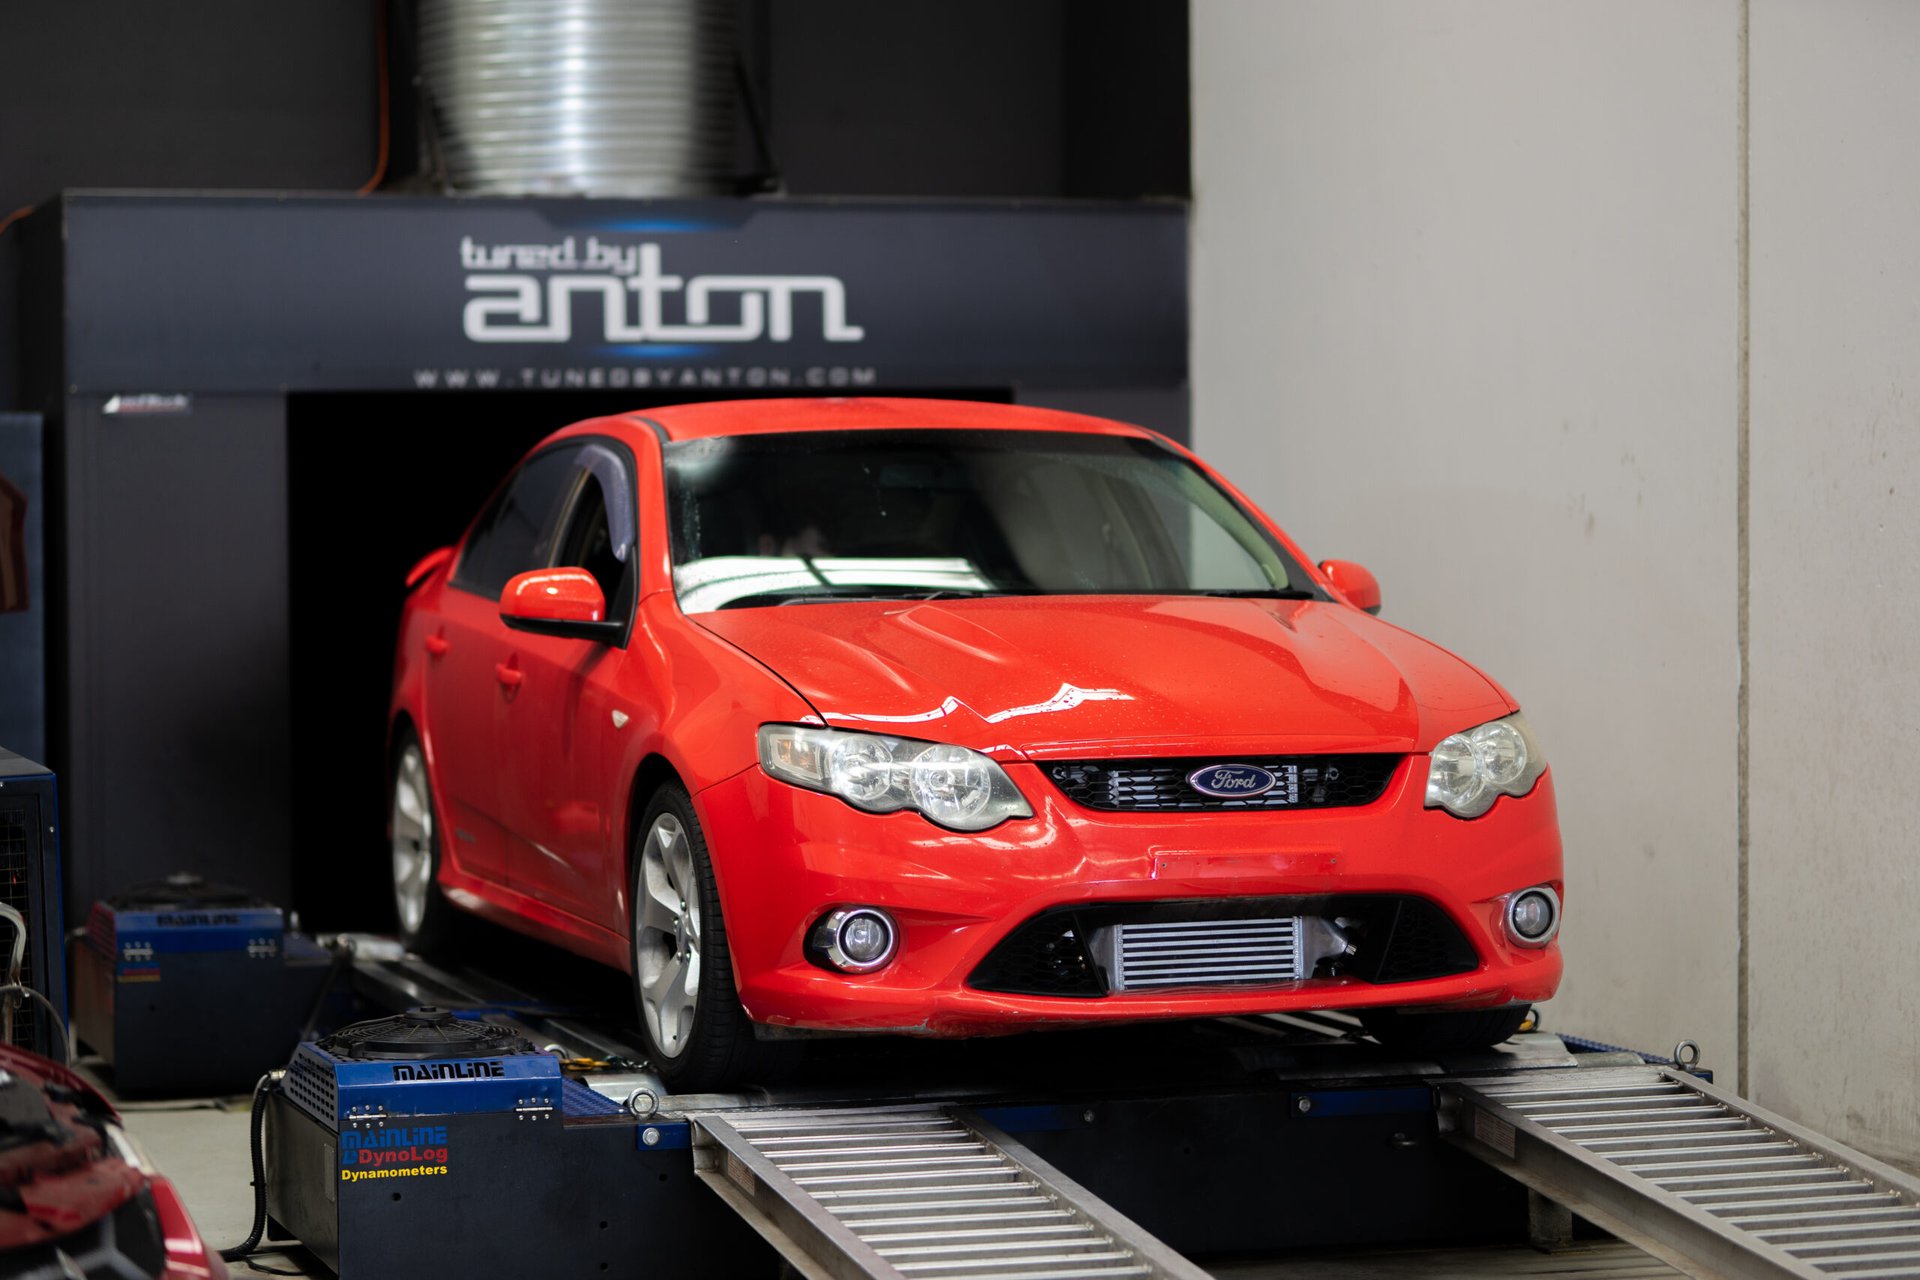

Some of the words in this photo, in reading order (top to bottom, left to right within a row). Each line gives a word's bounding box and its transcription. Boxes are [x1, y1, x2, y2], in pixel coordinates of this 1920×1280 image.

[583, 236, 637, 274] by
[463, 243, 865, 342] anton
[1211, 769, 1257, 789] Ford
[341, 1165, 448, 1182] Dynamometers
